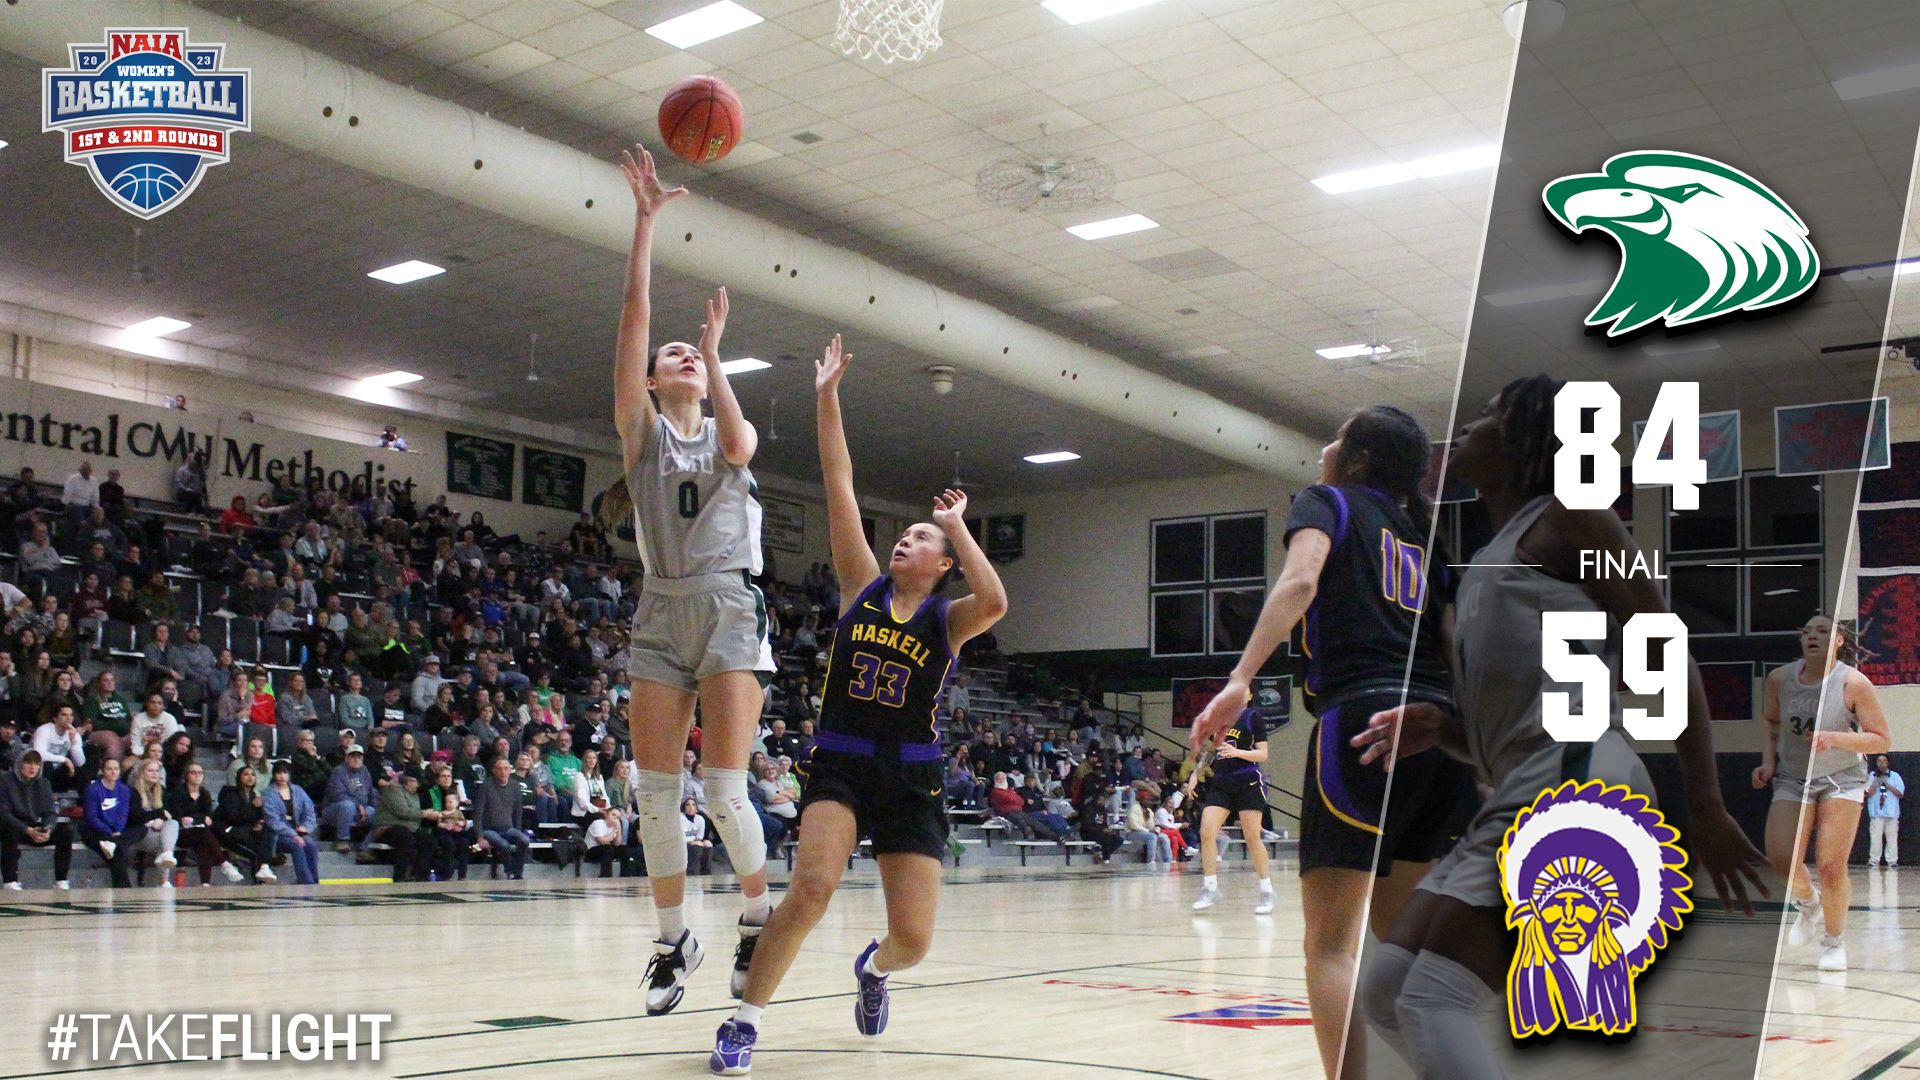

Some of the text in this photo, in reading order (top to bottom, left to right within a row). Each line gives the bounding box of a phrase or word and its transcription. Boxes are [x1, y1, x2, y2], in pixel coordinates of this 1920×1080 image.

[0, 412, 120, 458] ntral
[679, 481, 699, 519] 0
[1381, 527, 1430, 614] 10
[851, 623, 931, 668] HASKELL
[848, 651, 912, 708] 33
